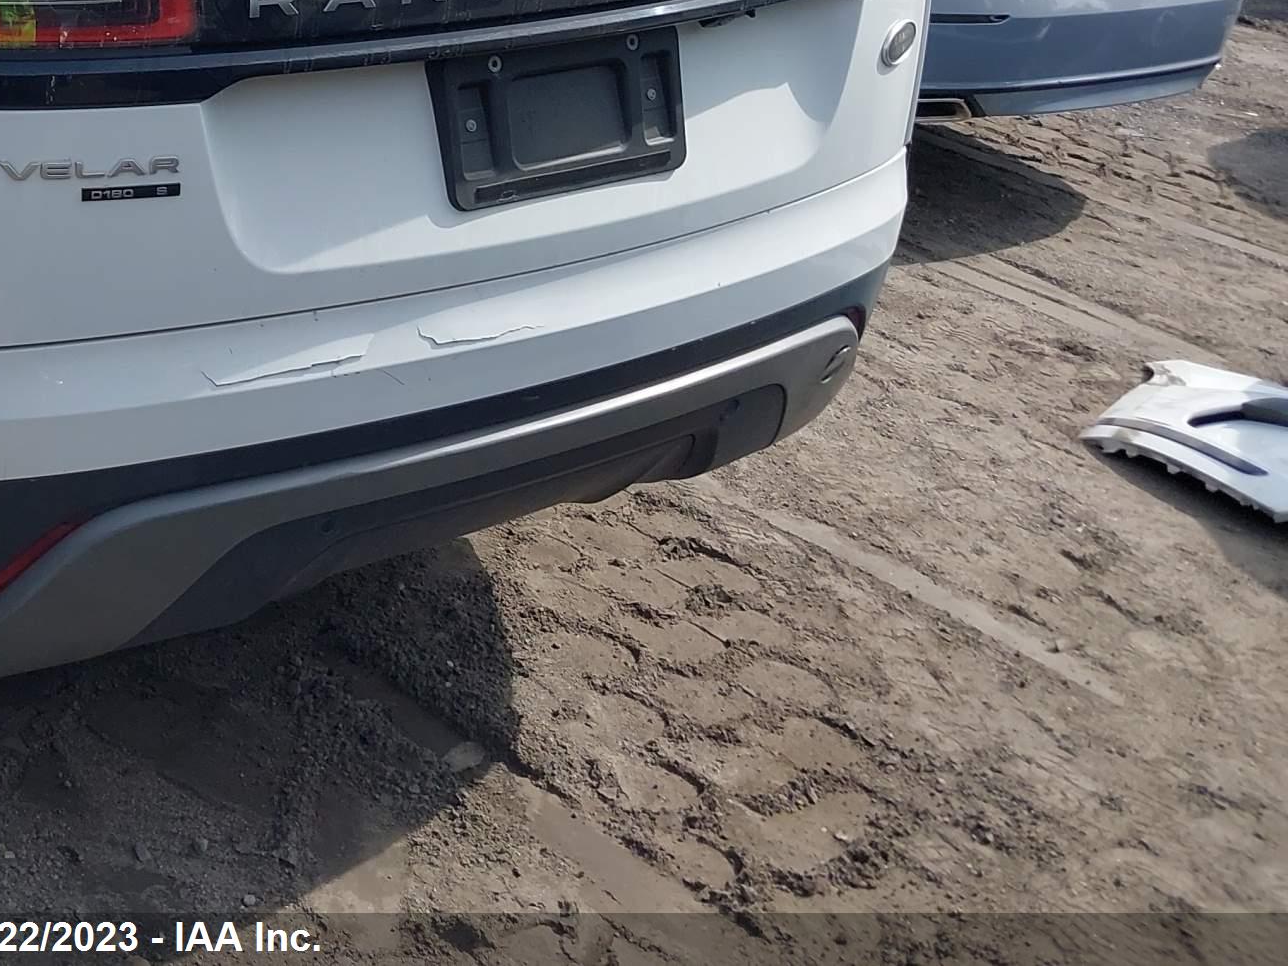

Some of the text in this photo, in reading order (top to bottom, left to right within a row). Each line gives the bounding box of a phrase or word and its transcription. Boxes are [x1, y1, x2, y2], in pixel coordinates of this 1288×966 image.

[0, 155, 180, 181] VELAR
[90, 186, 168, 200] D180 S
